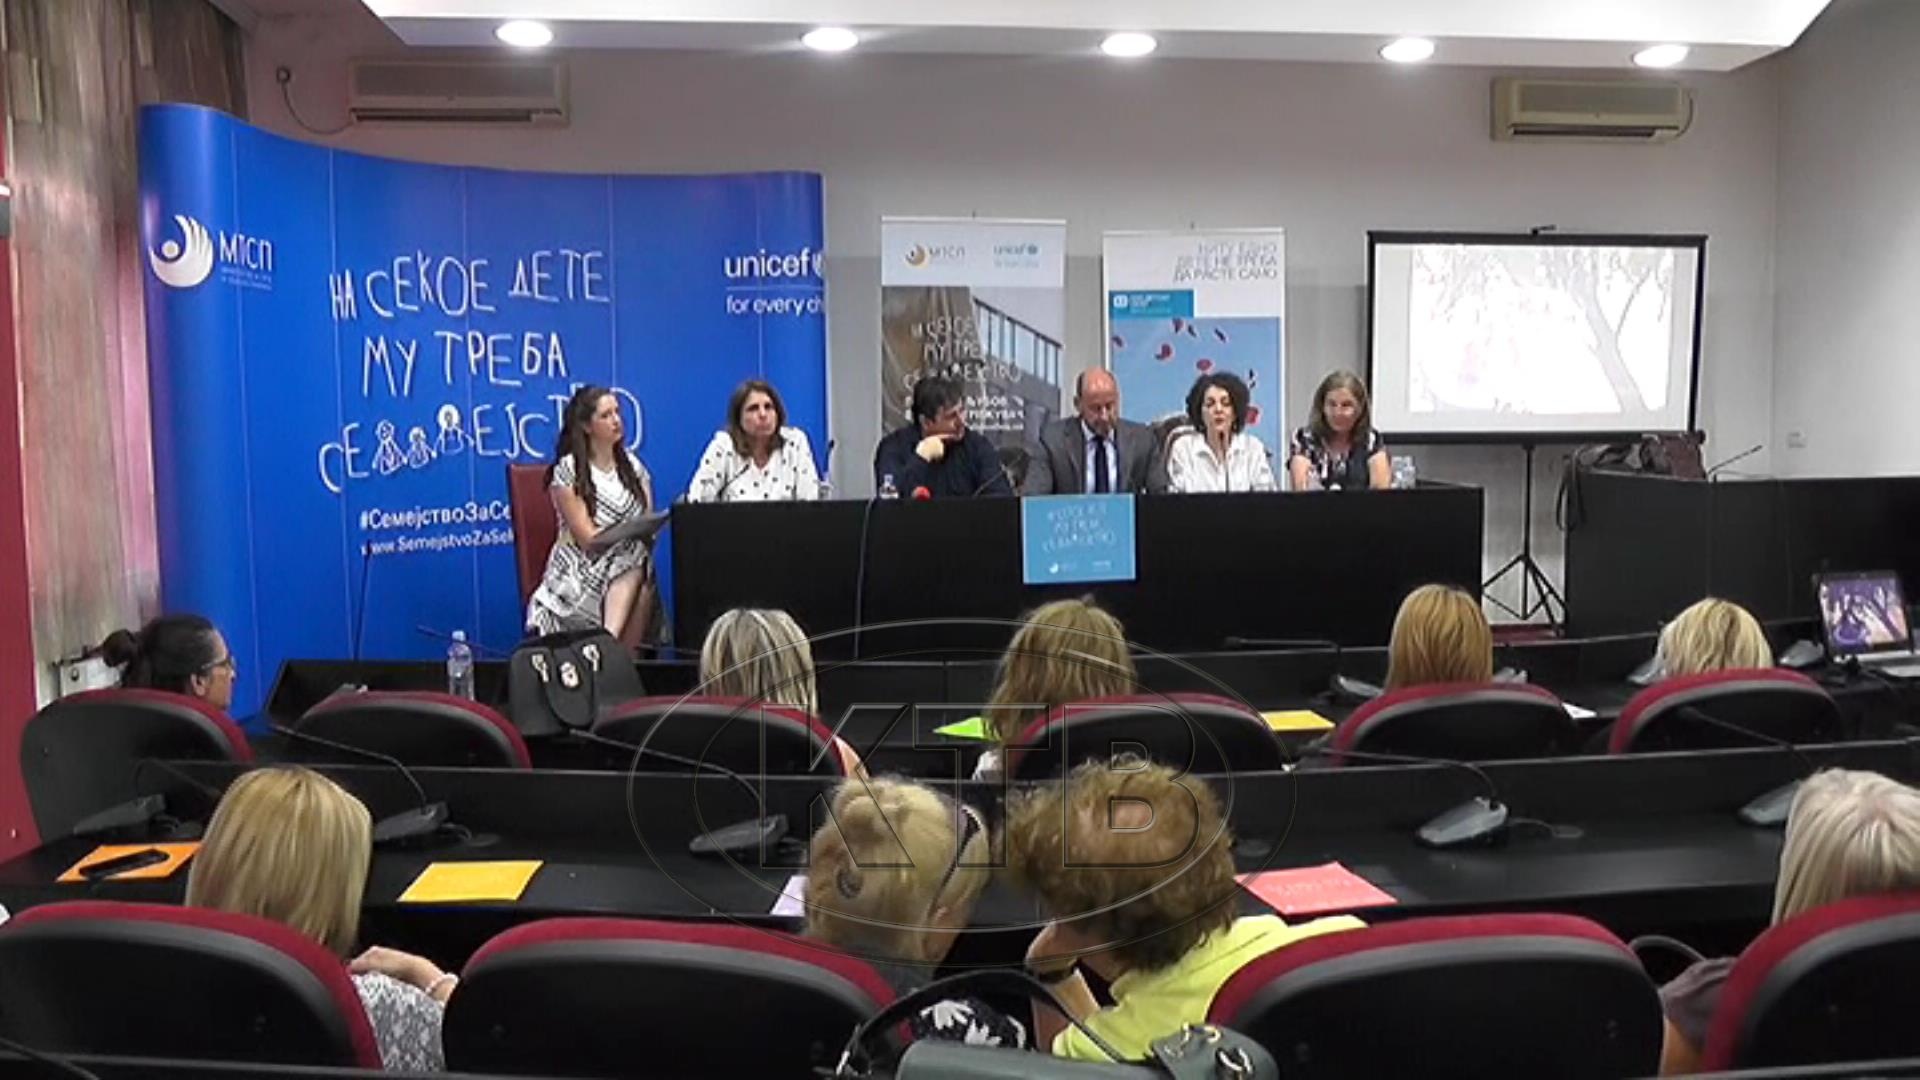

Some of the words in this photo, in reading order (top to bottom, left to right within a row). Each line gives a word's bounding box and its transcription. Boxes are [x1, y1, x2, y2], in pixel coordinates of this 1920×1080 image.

[366, 250, 496, 318] СЕКОЕ
[508, 249, 611, 302] ДЕТЕ
[724, 247, 810, 278] unicef
[726, 295, 749, 314] for
[753, 298, 805, 317] every
[363, 334, 417, 398] МУ
[433, 331, 568, 387] ТРЕБА
